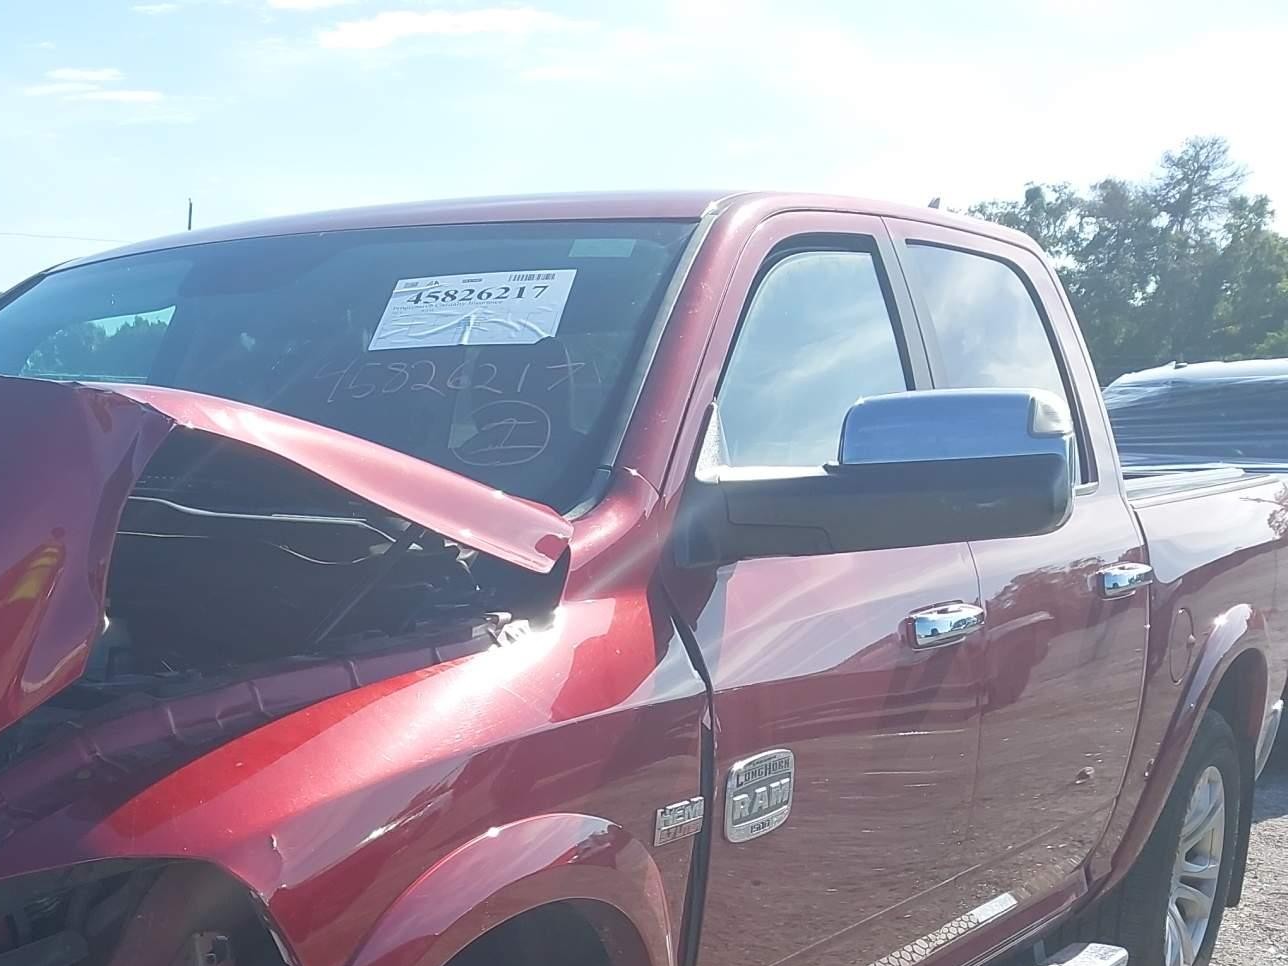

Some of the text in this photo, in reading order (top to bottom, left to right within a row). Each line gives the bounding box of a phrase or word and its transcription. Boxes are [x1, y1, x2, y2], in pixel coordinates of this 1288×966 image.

[406, 284, 550, 305] 45826217
[314, 357, 586, 403] 45826217
[732, 777, 791, 820] RAM
